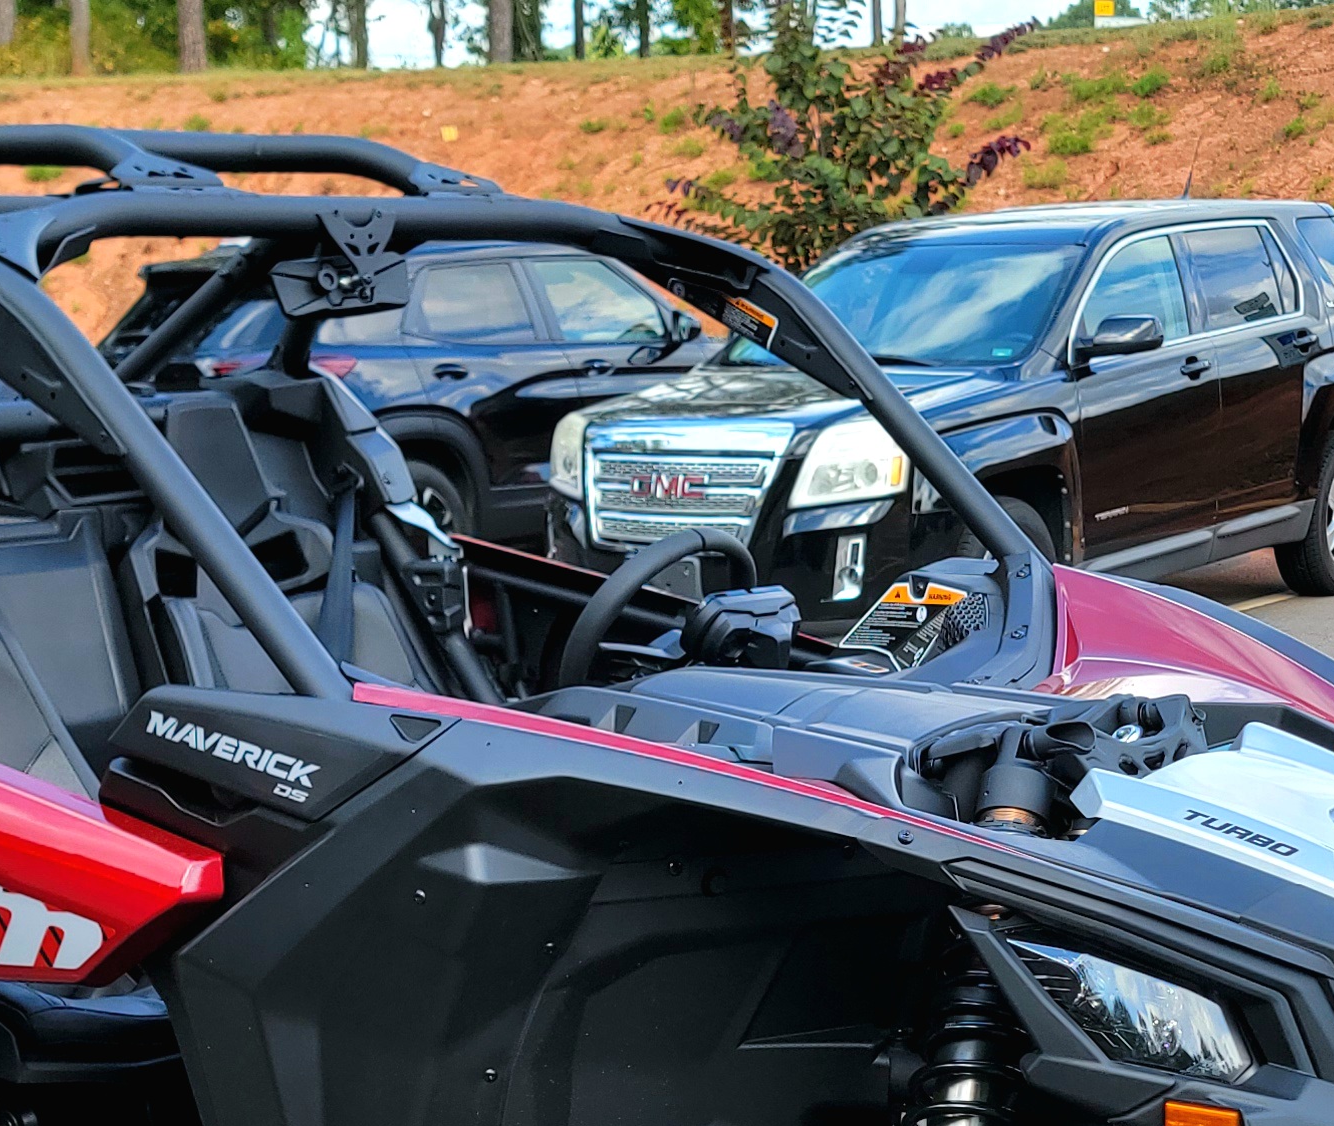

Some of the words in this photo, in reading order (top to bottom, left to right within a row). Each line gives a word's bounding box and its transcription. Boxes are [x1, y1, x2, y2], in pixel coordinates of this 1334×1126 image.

[630, 472, 709, 500] GMC
[145, 710, 322, 788] MAVERICK
[272, 783, 310, 803] DS
[1183, 808, 1299, 858] TURBO
